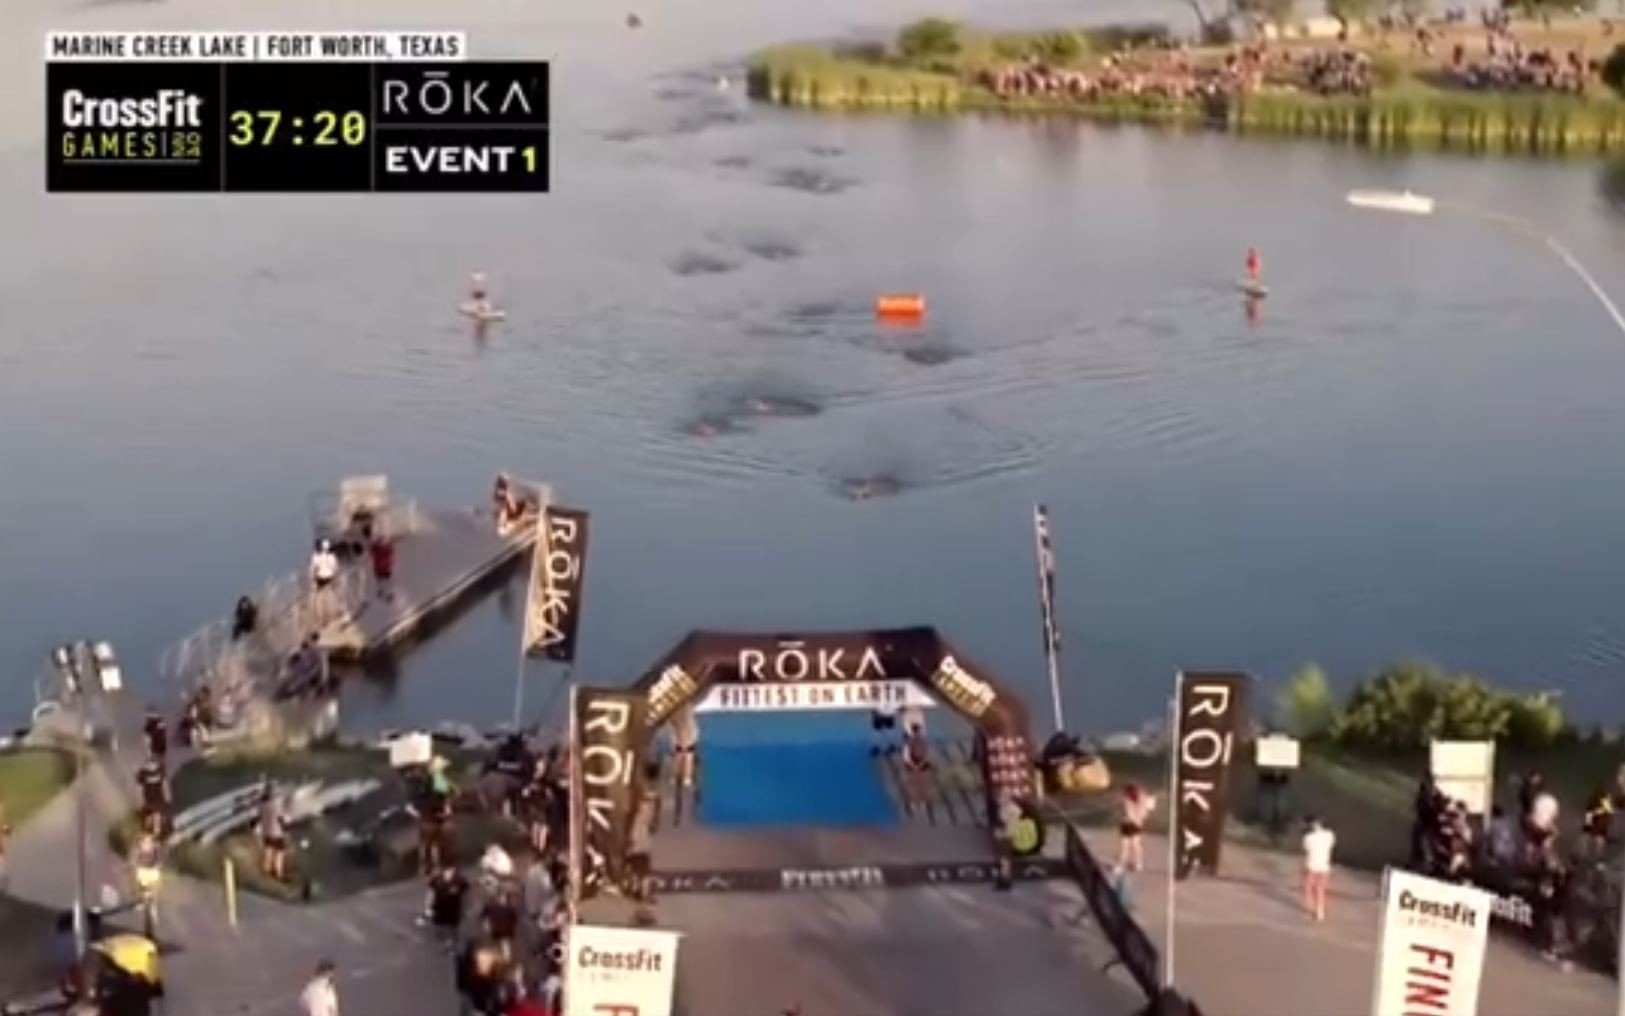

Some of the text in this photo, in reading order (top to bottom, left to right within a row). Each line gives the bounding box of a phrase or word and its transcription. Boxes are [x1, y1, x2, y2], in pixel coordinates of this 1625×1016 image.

[809, 687, 834, 704] ON
[845, 684, 906, 703] EARTH
[1399, 889, 1476, 928] CrossFit
[578, 945, 662, 972] CrossFit
[1401, 943, 1454, 1016] FIN
